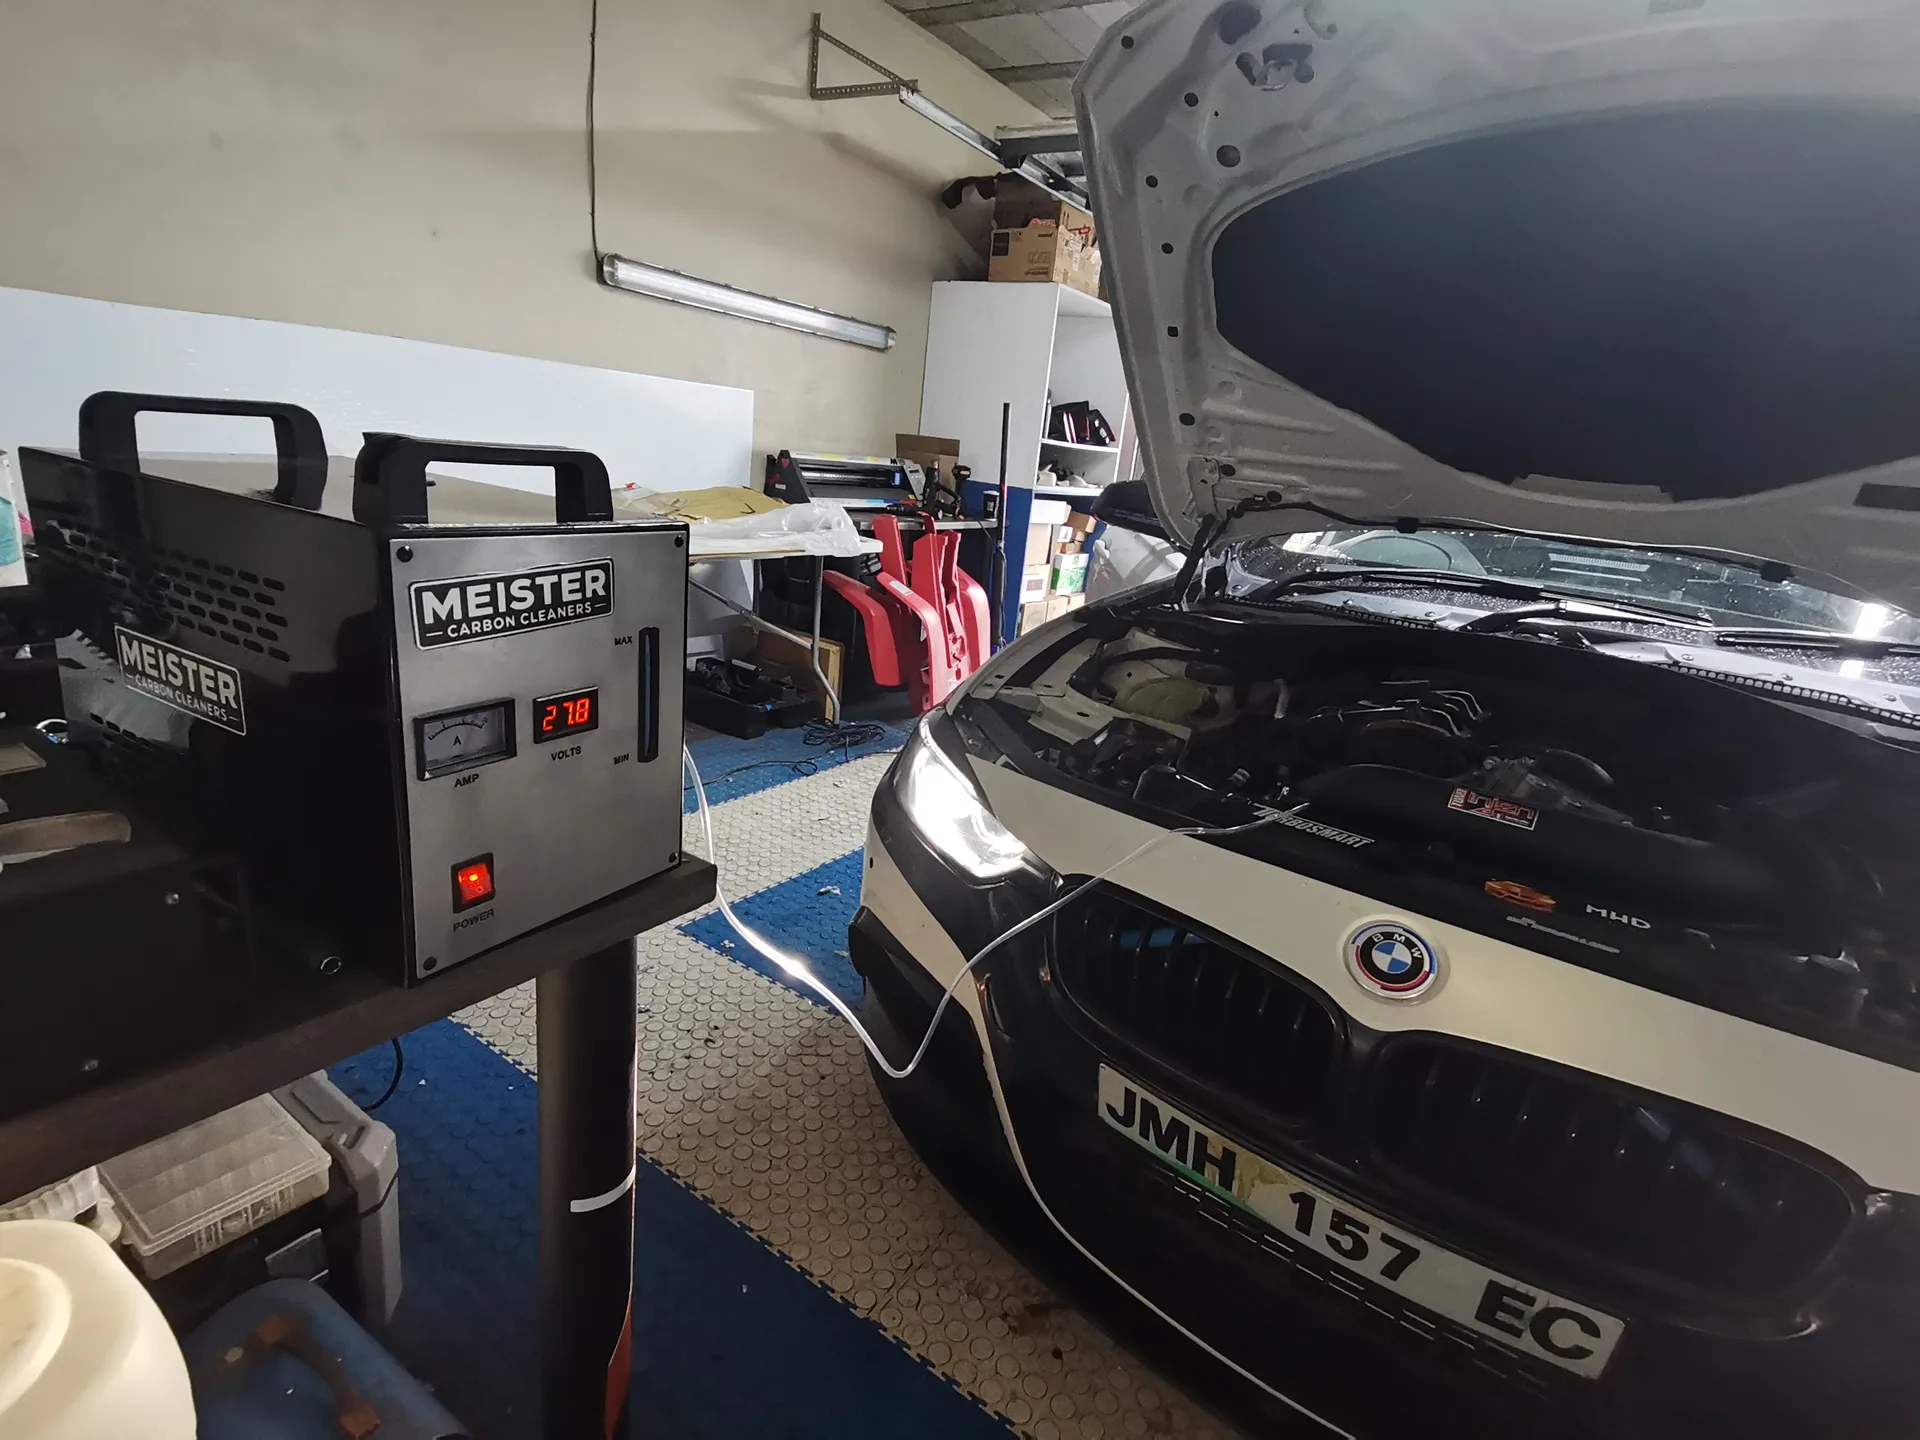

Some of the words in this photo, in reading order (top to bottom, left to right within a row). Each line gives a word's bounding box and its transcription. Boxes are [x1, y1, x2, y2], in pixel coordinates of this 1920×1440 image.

[421, 568, 607, 625] MEISTER
[447, 614, 516, 638] CARBON
[520, 602, 592, 625] CLEANERS
[614, 636, 633, 646] MAX
[120, 635, 238, 709] MEISTER
[135, 674, 174, 699] CARBON
[175, 690, 227, 721] CLEANERS
[453, 735, 462, 746] A
[551, 745, 582, 761] VOLTS
[613, 753, 630, 765] MIN
[454, 773, 479, 788] AMP
[452, 908, 495, 933] POWER
[1585, 904, 1651, 929] MHD
[1371, 932, 1423, 959] BMW
[1106, 1085, 1237, 1192] JMH
[1290, 1191, 1421, 1282] 157
[1474, 1279, 1601, 1361] EC
